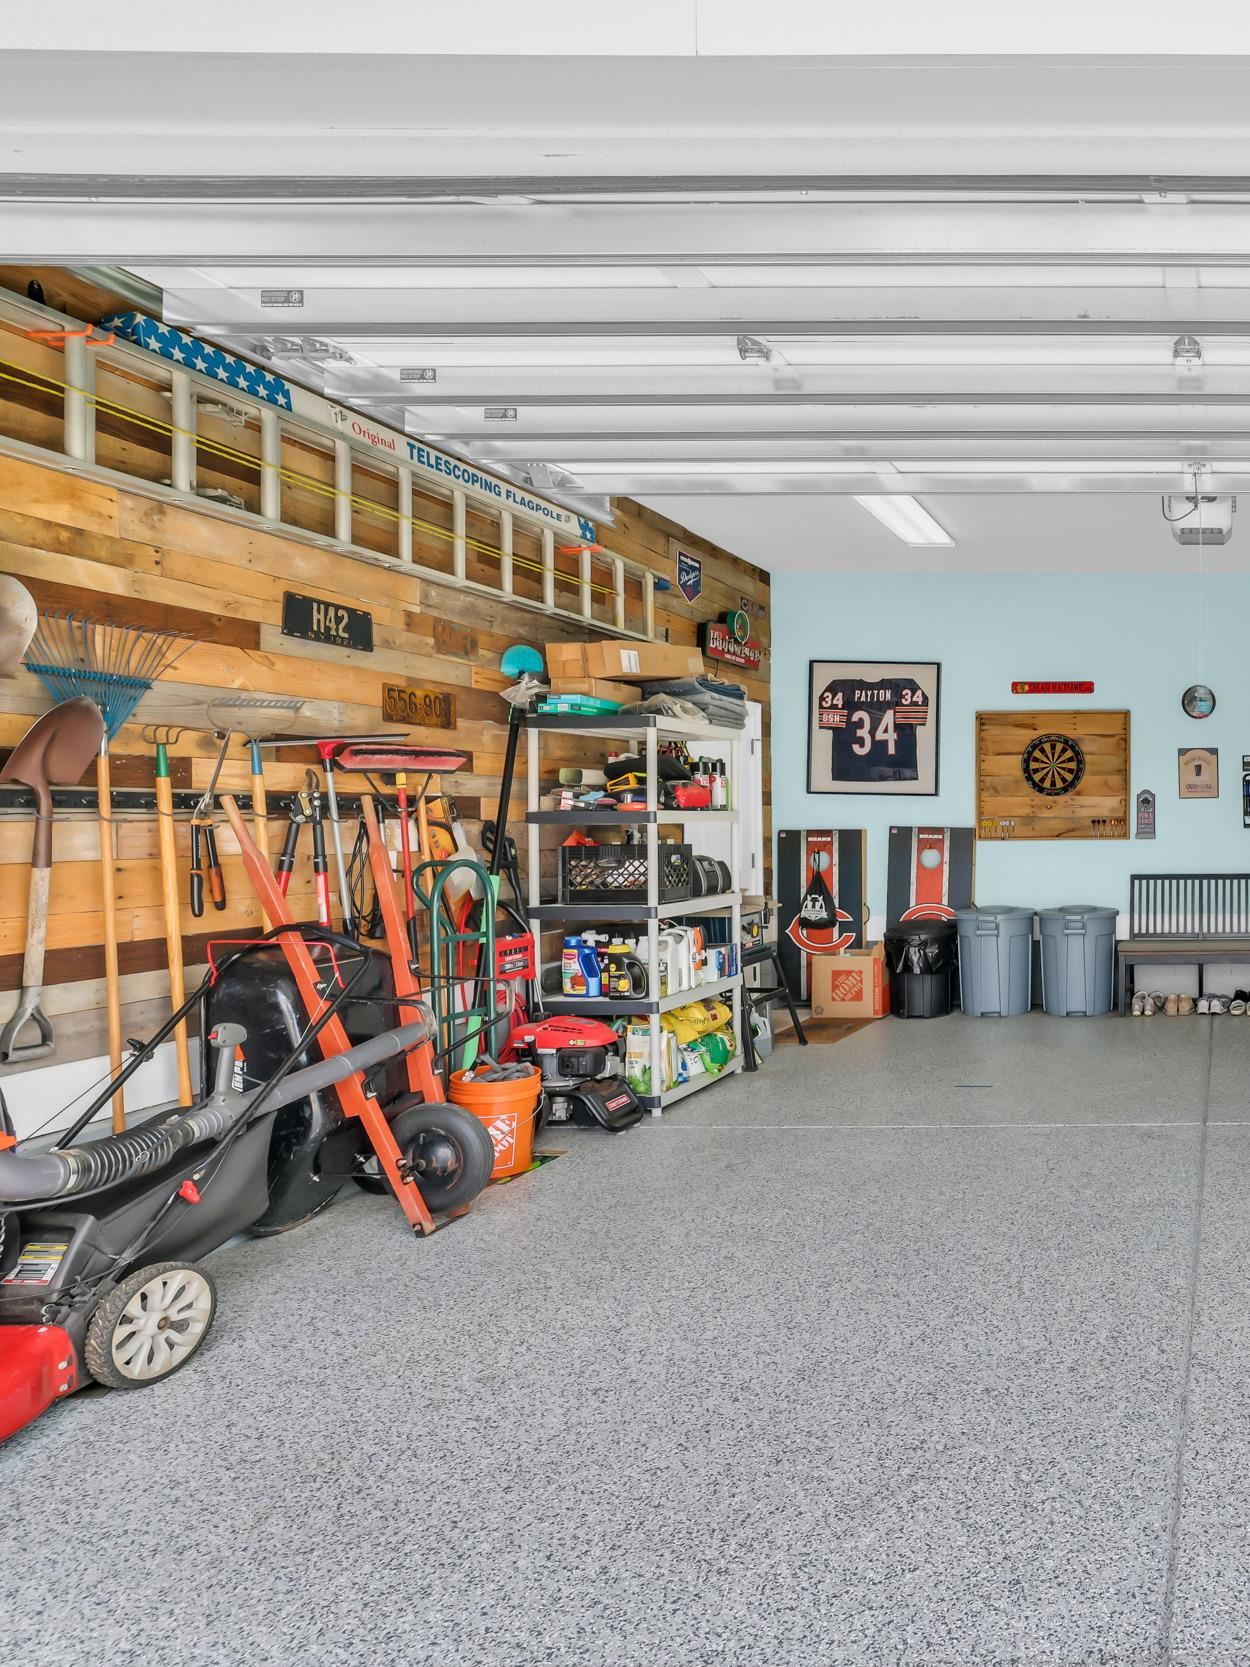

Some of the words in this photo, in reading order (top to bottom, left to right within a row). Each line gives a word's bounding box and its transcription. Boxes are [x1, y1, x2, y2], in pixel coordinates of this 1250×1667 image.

[351, 421, 396, 451] Original
[407, 442, 501, 497] TELESCOPING
[506, 490, 562, 522] FLAGPOLE
[312, 601, 349, 638] H42
[821, 691, 843, 708] 34
[855, 690, 891, 702] PAYTON
[901, 689, 923, 705] 34
[851, 709, 897, 755] 34
[832, 971, 862, 1001] HOME
